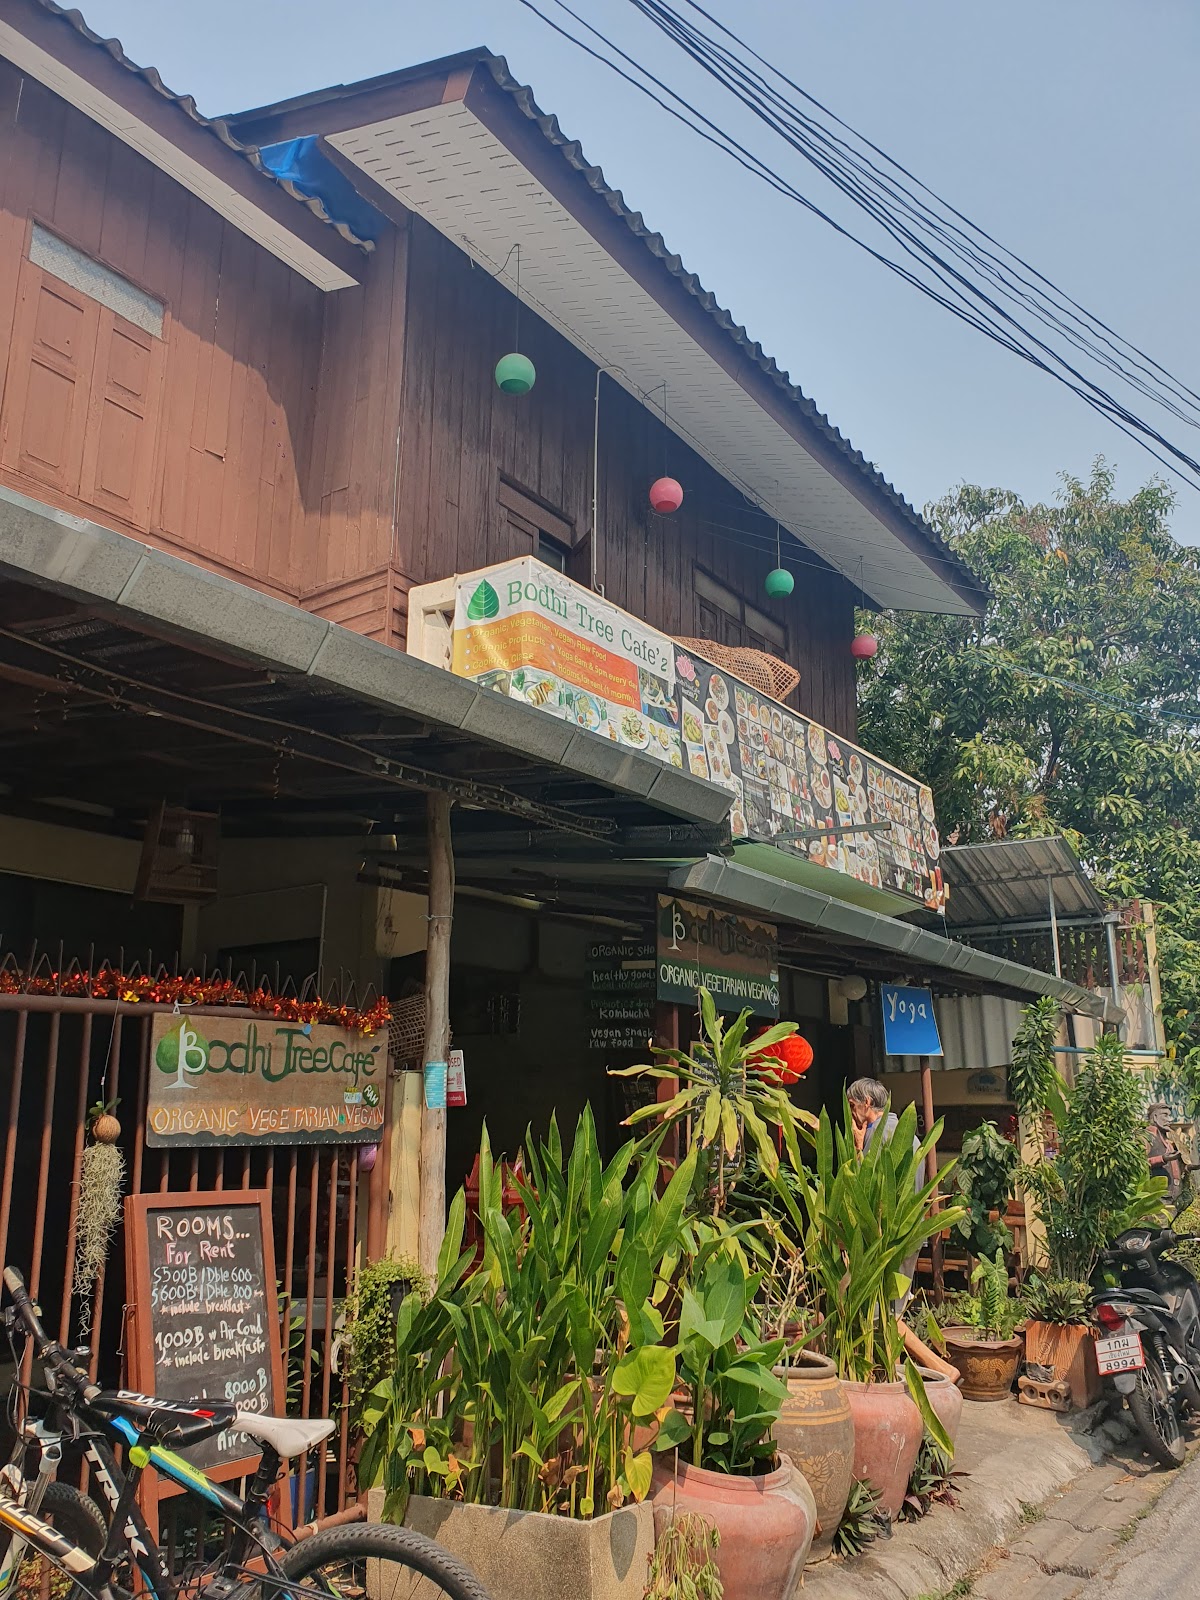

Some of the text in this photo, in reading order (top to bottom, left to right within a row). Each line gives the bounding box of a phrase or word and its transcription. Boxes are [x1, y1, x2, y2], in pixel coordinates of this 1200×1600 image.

[507, 580, 568, 619] Bodhi
[576, 603, 614, 642] Tree
[660, 656, 668, 673] 2
[473, 642, 508, 654] Organic
[577, 640, 591, 653] Raw
[592, 649, 607, 662] Food
[473, 652, 535, 670] Cooking Class
[557, 646, 573, 666] Yoga
[588, 662, 594, 671] &
[595, 665, 608, 679] 5pm
[608, 673, 627, 687] every
[628, 679, 638, 692] day
[592, 945, 634, 957] ORGANIC
[593, 969, 656, 982] healthy goods
[660, 964, 699, 988] ORGANIC
[701, 972, 747, 996] VEGETARIAN
[747, 981, 771, 999] VEGAN
[887, 991, 927, 1024] Yoga
[589, 1037, 634, 1049] raw food
[364, 1085, 379, 1105] RAW
[152, 1105, 385, 1132] ORGANIC VEGETARIAN VEGAN
[166, 1240, 235, 1265] For Rent
[231, 1266, 253, 1282] 600
[1106, 1358, 1136, 1371] 8994
[217, 1431, 239, 1452] Air
